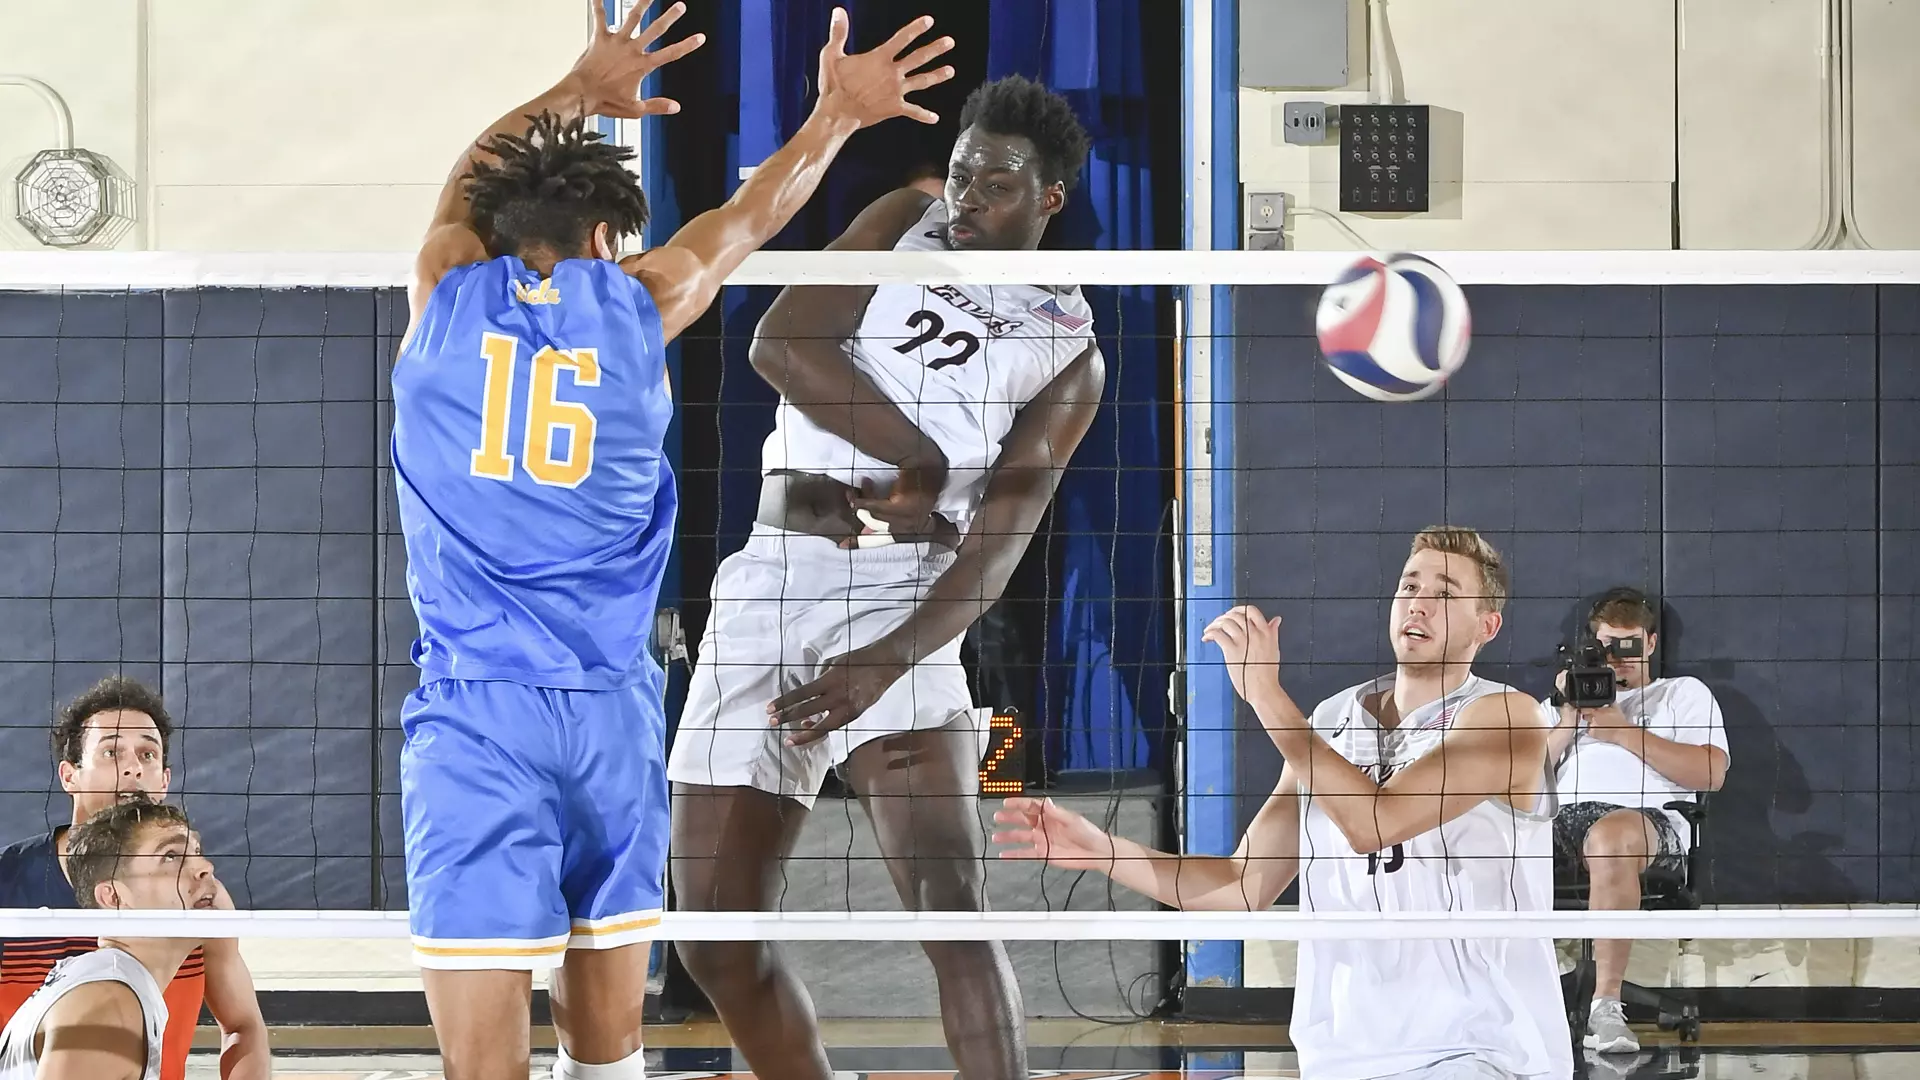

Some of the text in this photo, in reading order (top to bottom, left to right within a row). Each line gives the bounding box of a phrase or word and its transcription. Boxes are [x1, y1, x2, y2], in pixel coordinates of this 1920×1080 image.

[892, 309, 980, 371] 22
[470, 331, 602, 489] 16
[979, 715, 1022, 792] 2
